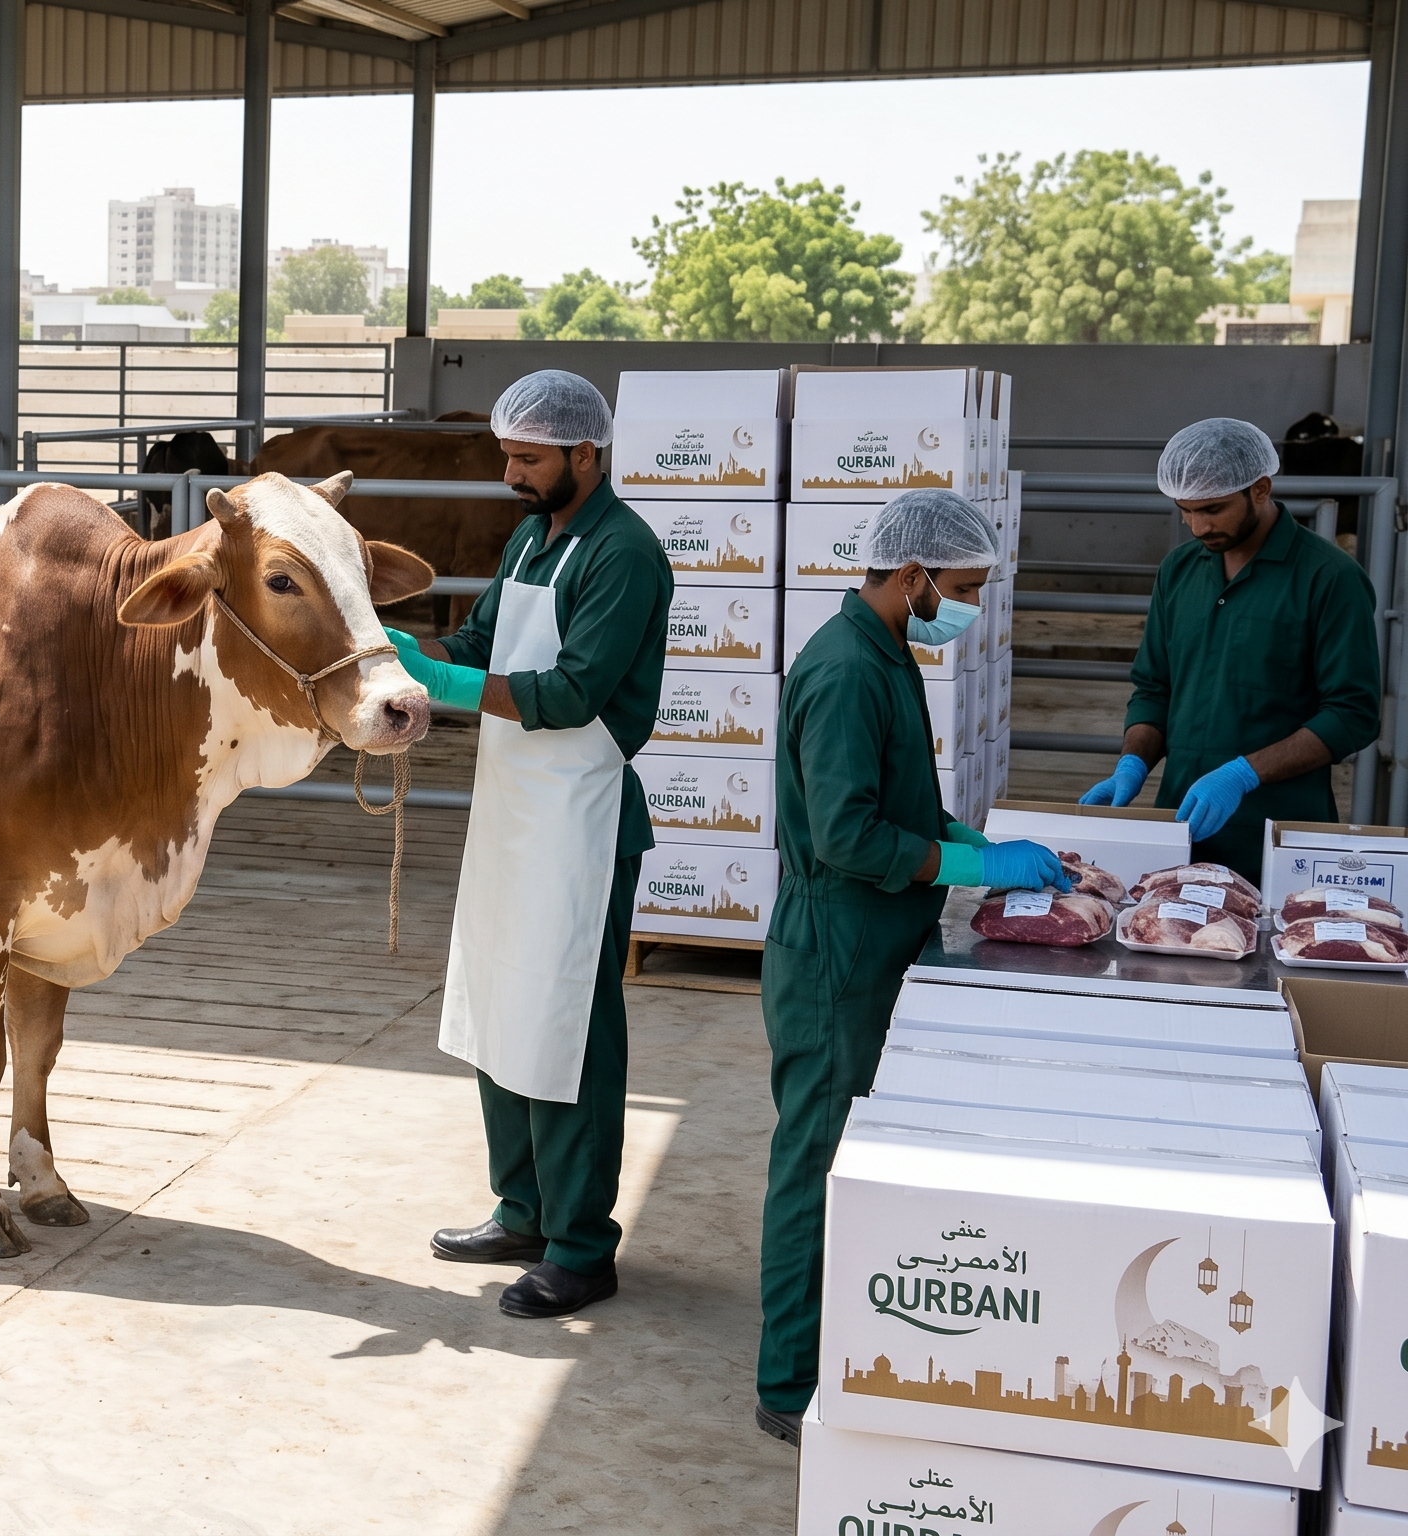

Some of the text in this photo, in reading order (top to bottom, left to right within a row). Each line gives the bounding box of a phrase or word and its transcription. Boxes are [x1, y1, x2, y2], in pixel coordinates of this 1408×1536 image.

[656, 453, 711, 471] QURBANI
[837, 455, 895, 474] QURBANI
[658, 538, 709, 556] URBANI
[669, 623, 707, 640] RBANI
[648, 793, 705, 812] QURBANI
[648, 880, 704, 901] QURBANI
[868, 1272, 1040, 1335] QURBANI
